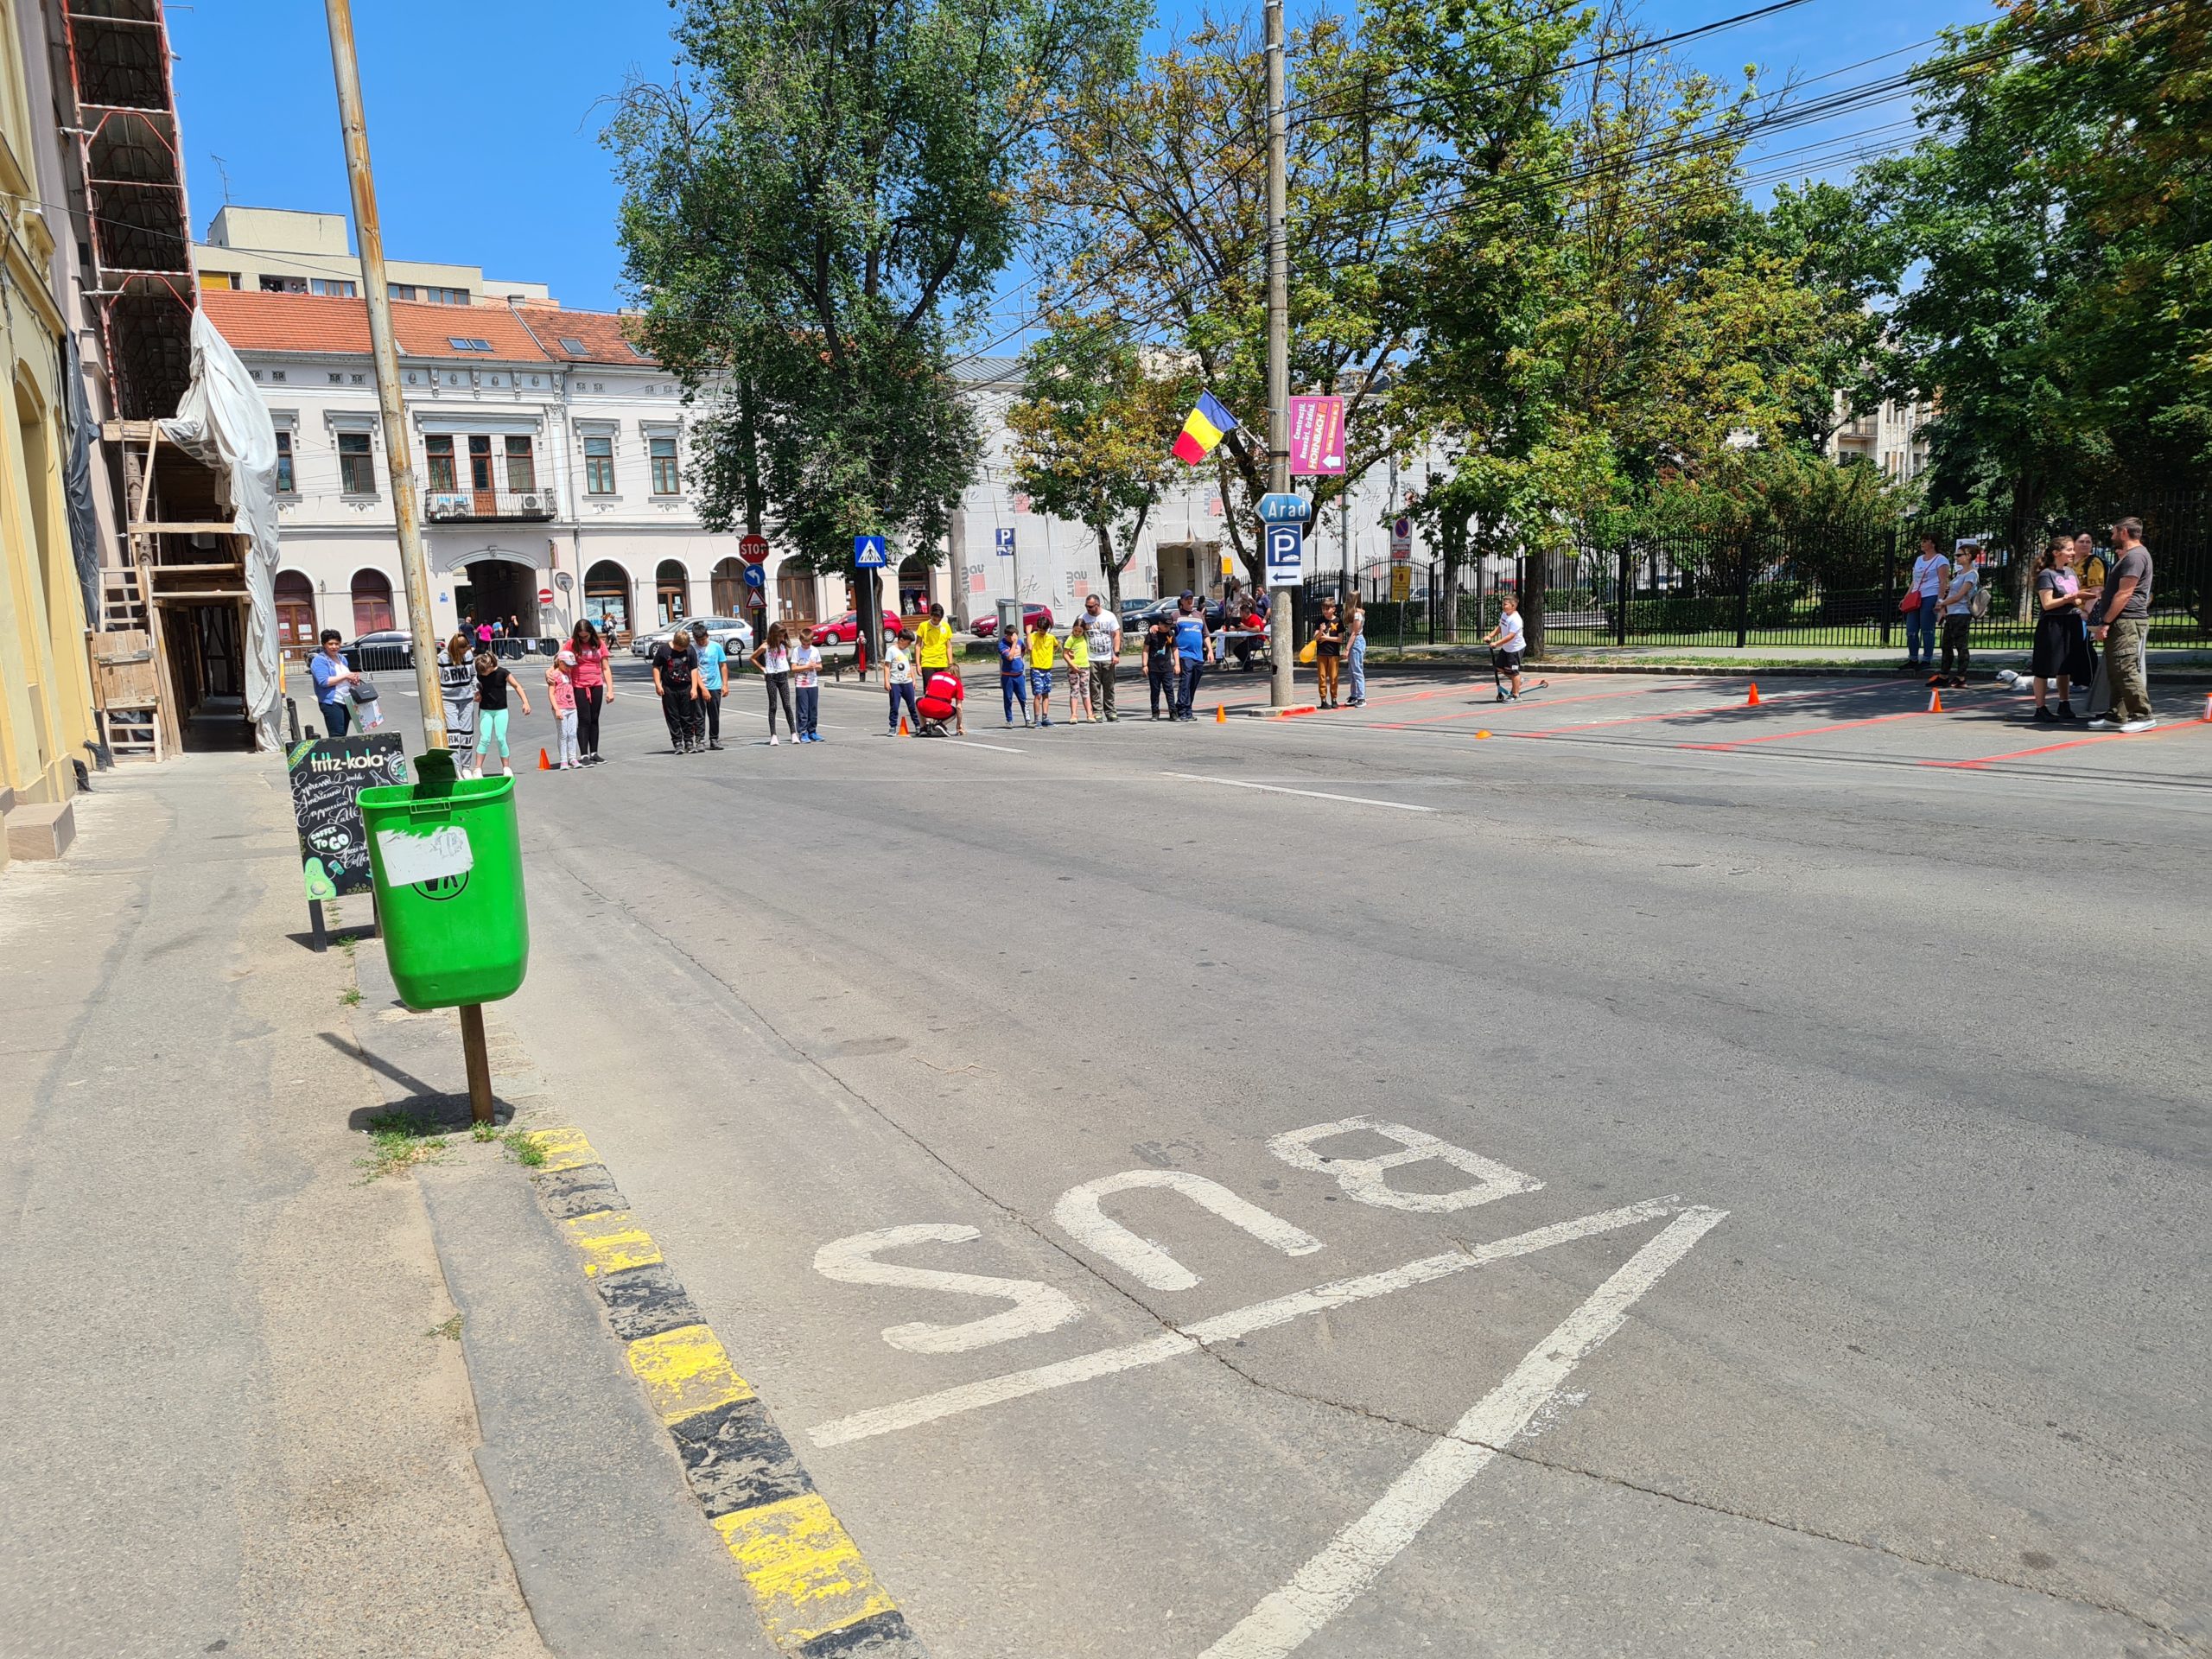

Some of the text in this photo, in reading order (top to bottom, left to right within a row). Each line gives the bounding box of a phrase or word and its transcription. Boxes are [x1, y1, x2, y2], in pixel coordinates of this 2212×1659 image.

[1309, 414, 1325, 469] HORNBACH
[1268, 500, 1306, 518] Arad
[1001, 529, 1011, 545] P
[741, 543, 766, 555] STOP
[1274, 534, 1295, 563] P
[311, 748, 384, 772] fritz-kola
[310, 826, 337, 841] COFFEE
[328, 833, 349, 850] GO
